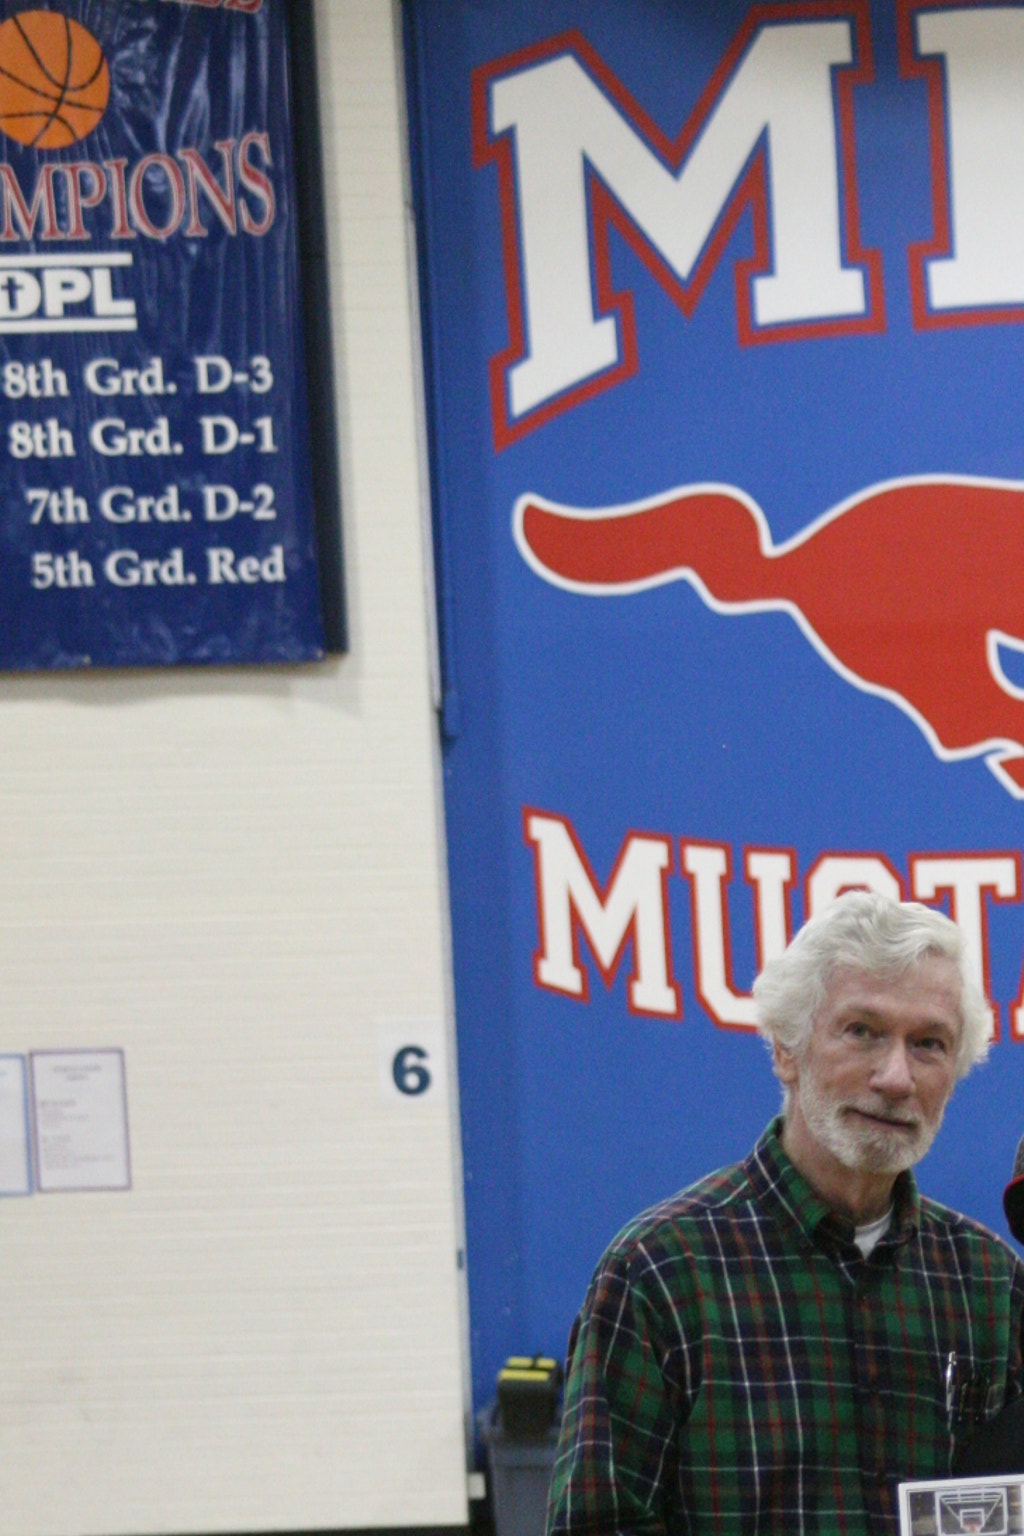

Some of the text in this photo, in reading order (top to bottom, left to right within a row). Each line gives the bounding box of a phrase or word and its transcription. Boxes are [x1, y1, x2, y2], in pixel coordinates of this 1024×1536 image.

[0, 267, 136, 319] DPL
[3, 355, 274, 399] 8th Grd. D-3
[9, 415, 278, 459] 8th Grd. D-1
[27, 483, 277, 525] 7th Grd. D-2
[32, 545, 286, 590] 5th Grd. Red
[391, 1044, 431, 1096] 6
